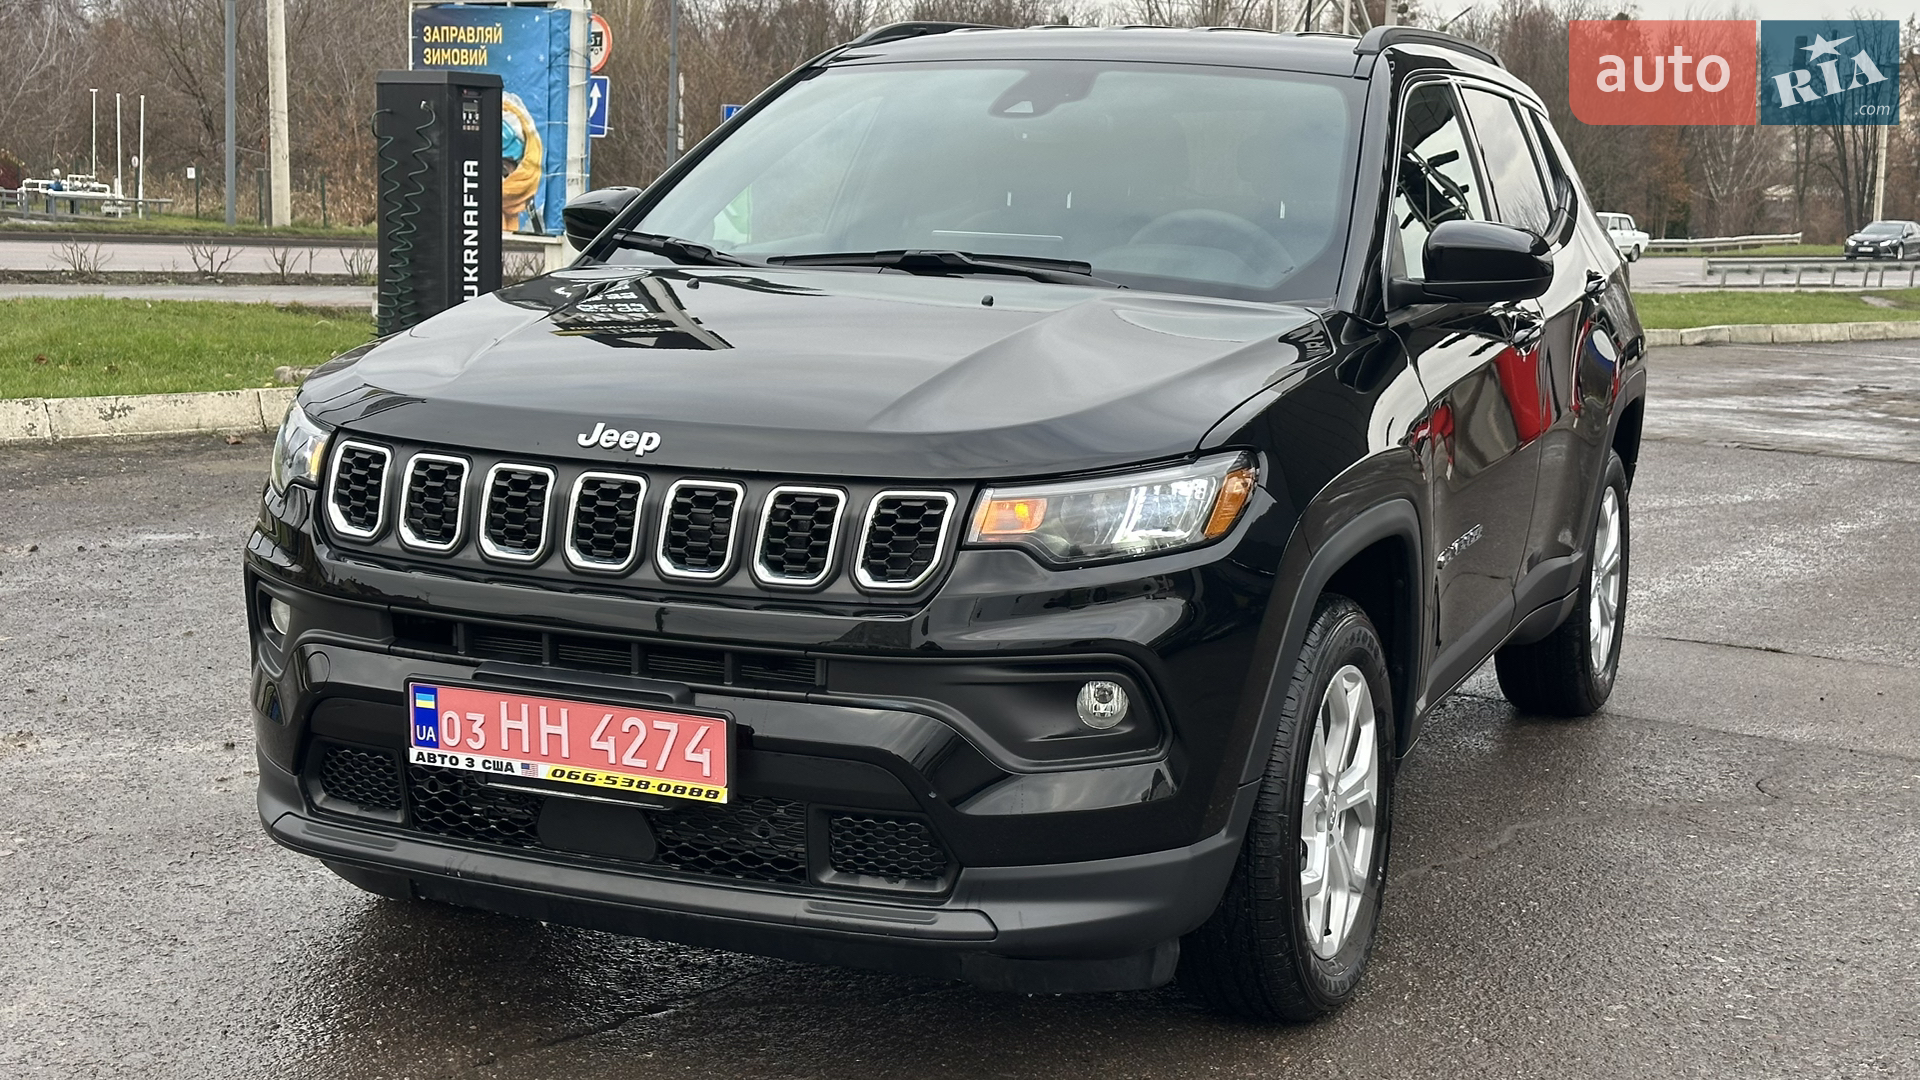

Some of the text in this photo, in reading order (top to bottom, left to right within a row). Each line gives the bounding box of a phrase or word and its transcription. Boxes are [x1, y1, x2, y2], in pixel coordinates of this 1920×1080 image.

[423, 23, 503, 44] ЗАПРАВЛЯЙ
[423, 45, 488, 66] ЗИМОВИЙ
[463, 160, 479, 301] UKRNAFTA
[577, 422, 661, 457] Jeep
[416, 724, 436, 742] UA
[441, 710, 486, 750] 03
[590, 713, 711, 778] 4274
[415, 751, 459, 768] АВТО
[481, 759, 515, 774] США
